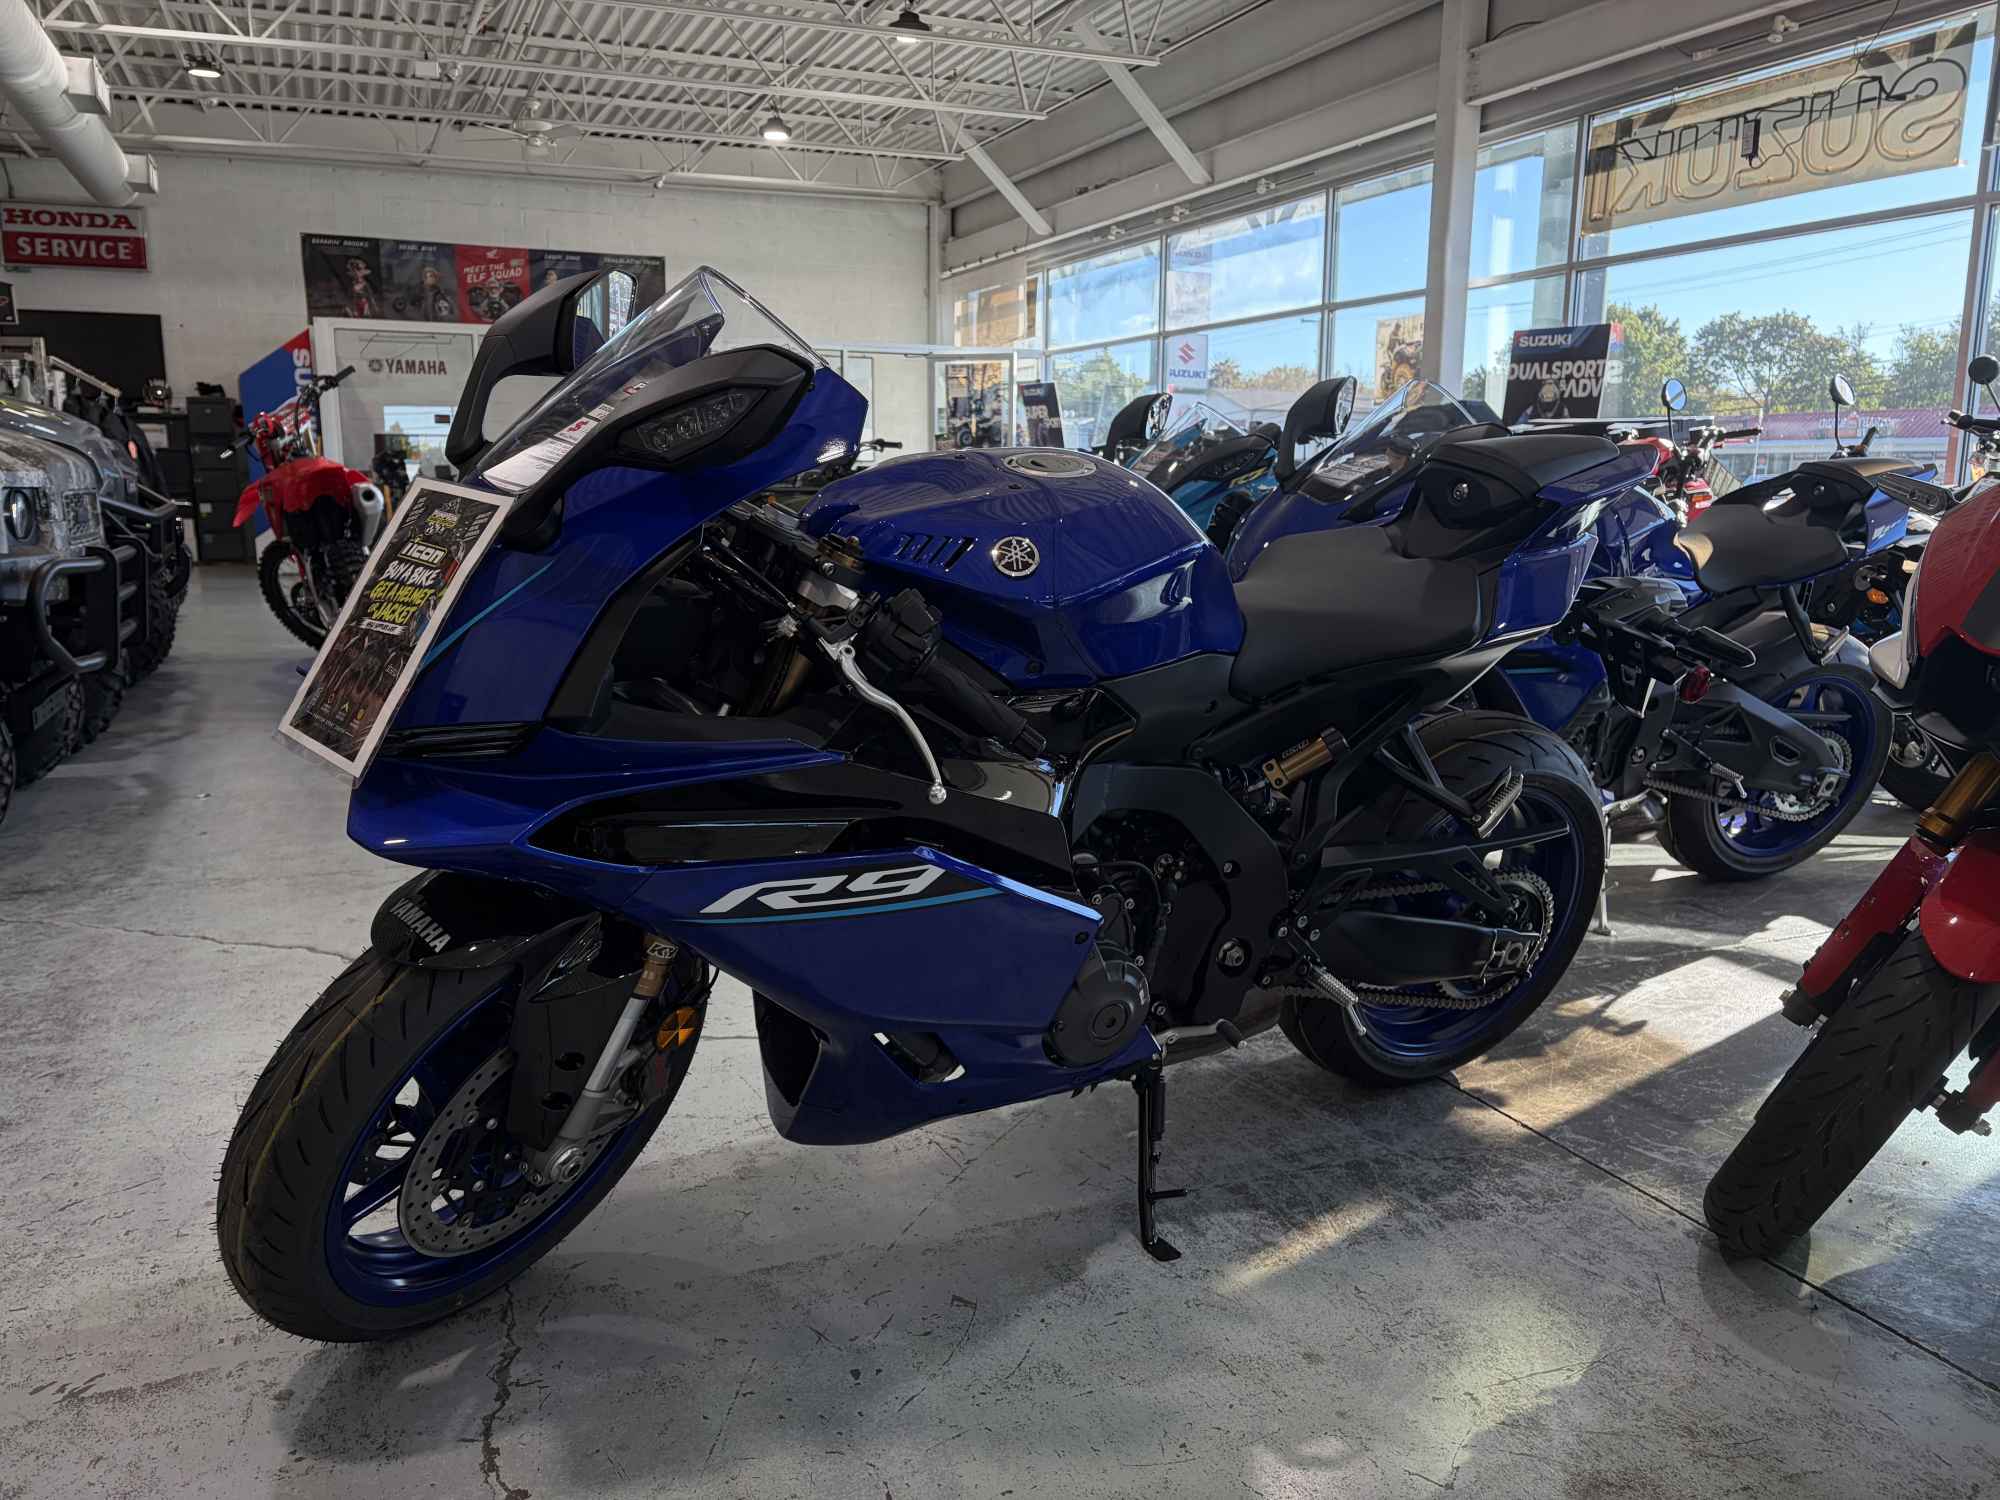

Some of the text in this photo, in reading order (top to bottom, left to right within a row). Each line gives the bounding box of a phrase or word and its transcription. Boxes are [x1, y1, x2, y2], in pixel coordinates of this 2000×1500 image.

[2, 208, 137, 230] HONDA
[16, 236, 133, 260] SERVICE
[463, 263, 487, 275] MEET
[489, 262, 505, 272] THE
[466, 267, 523, 285] ELF SQUAD
[1519, 333, 1572, 348] SUZUKI
[385, 358, 448, 376] YAMAHA
[1508, 359, 1606, 381] DUALSPORT
[379, 559, 411, 582] BUY
[409, 567, 442, 588] BIKE
[372, 601, 418, 625] JACKET
[699, 864, 946, 914] R9
[389, 897, 451, 953] YAMAHA
